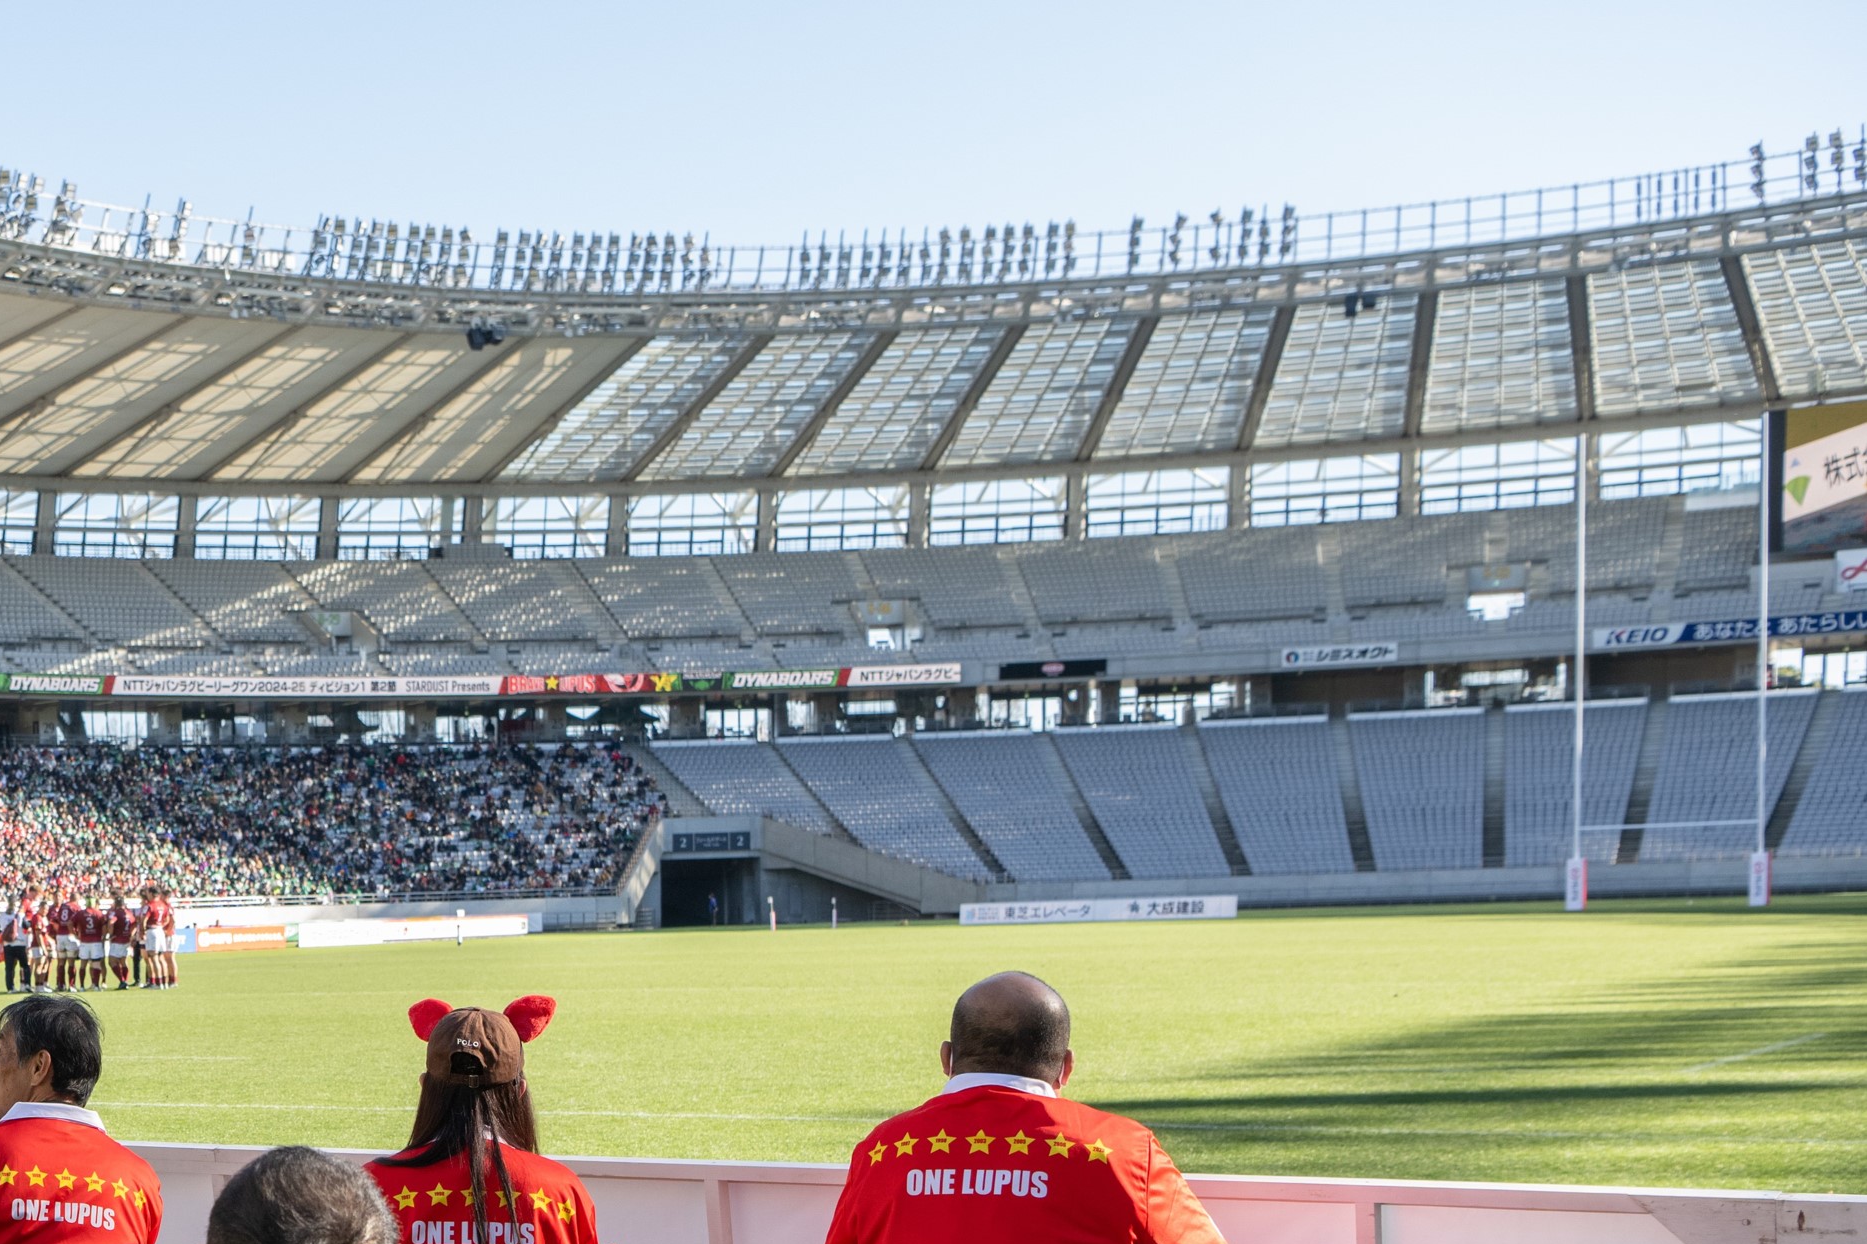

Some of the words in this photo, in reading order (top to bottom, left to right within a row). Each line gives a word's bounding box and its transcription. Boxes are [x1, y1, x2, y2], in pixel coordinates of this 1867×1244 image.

[1824, 447, 1867, 488] 株式
[1607, 627, 1669, 645] KEIO
[9, 675, 101, 692] DYNABOARS
[405, 680, 449, 693] STARDUST
[451, 680, 490, 693] Presents
[732, 669, 834, 688] DYNABOARS
[1004, 906, 1090, 920] 東芝エレベータ
[1146, 900, 1205, 916] 大成建設
[456, 1037, 479, 1048] POLO
[906, 1168, 956, 1196] ONE
[961, 1169, 1049, 1198] LUPUS
[11, 1198, 50, 1221] ONE
[54, 1201, 116, 1231] LUPUS
